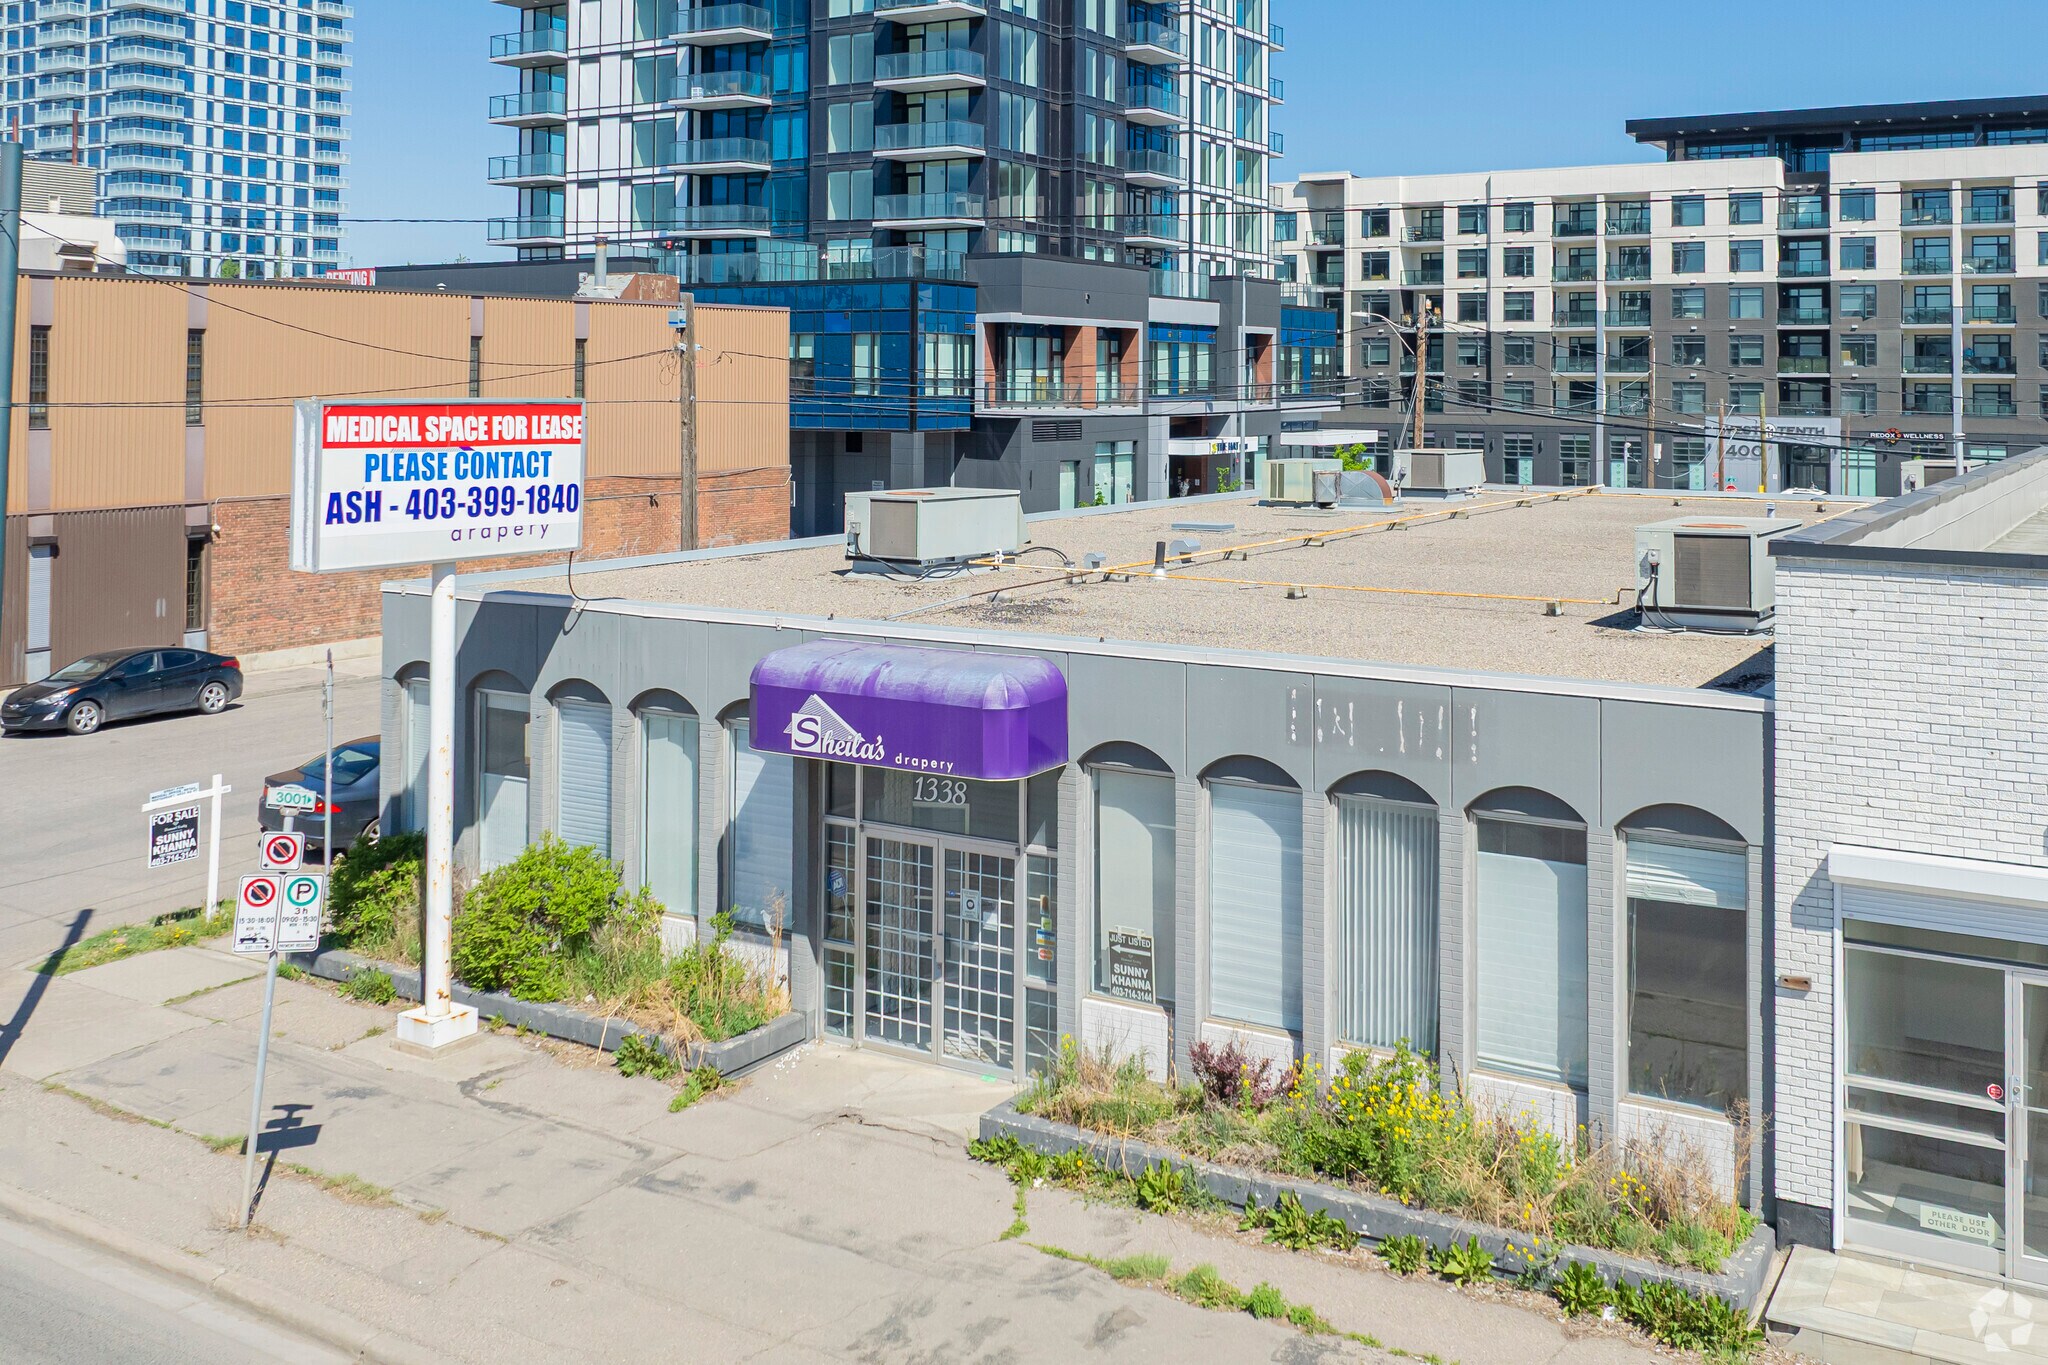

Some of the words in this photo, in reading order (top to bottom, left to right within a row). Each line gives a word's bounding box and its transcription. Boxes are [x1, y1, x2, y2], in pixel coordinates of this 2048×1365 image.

[326, 414, 422, 443] MEDICAL
[425, 414, 489, 442] SPACE
[492, 415, 528, 441] FOR
[531, 414, 582, 440] LEASE
[364, 452, 448, 482] PLEASE
[454, 450, 552, 480] CONTACT
[325, 490, 383, 525] ASH
[405, 483, 579, 520] 403-399-1840
[793, 717, 885, 761] Sheila's
[895, 753, 954, 772] drapery
[276, 791, 307, 805] 3001
[914, 776, 967, 805] 1338
[152, 813, 174, 826] FOR
[175, 807, 199, 821] SALE
[156, 828, 195, 846] SUNNY
[152, 838, 197, 856] KHANNA
[151, 849, 198, 866] 403-714-3144
[1110, 934, 1127, 944] JUST
[1128, 937, 1151, 948] LISTED
[1113, 963, 1149, 979] SUNNY
[1111, 974, 1152, 991] KHANNA
[1112, 986, 1152, 1002] 403-714-3144
[1928, 1218, 1957, 1230] OTHER
[1962, 1225, 1990, 1237] DOOR
[1932, 1211, 1964, 1223] PLEASE
[1969, 1218, 1986, 1228] USE
